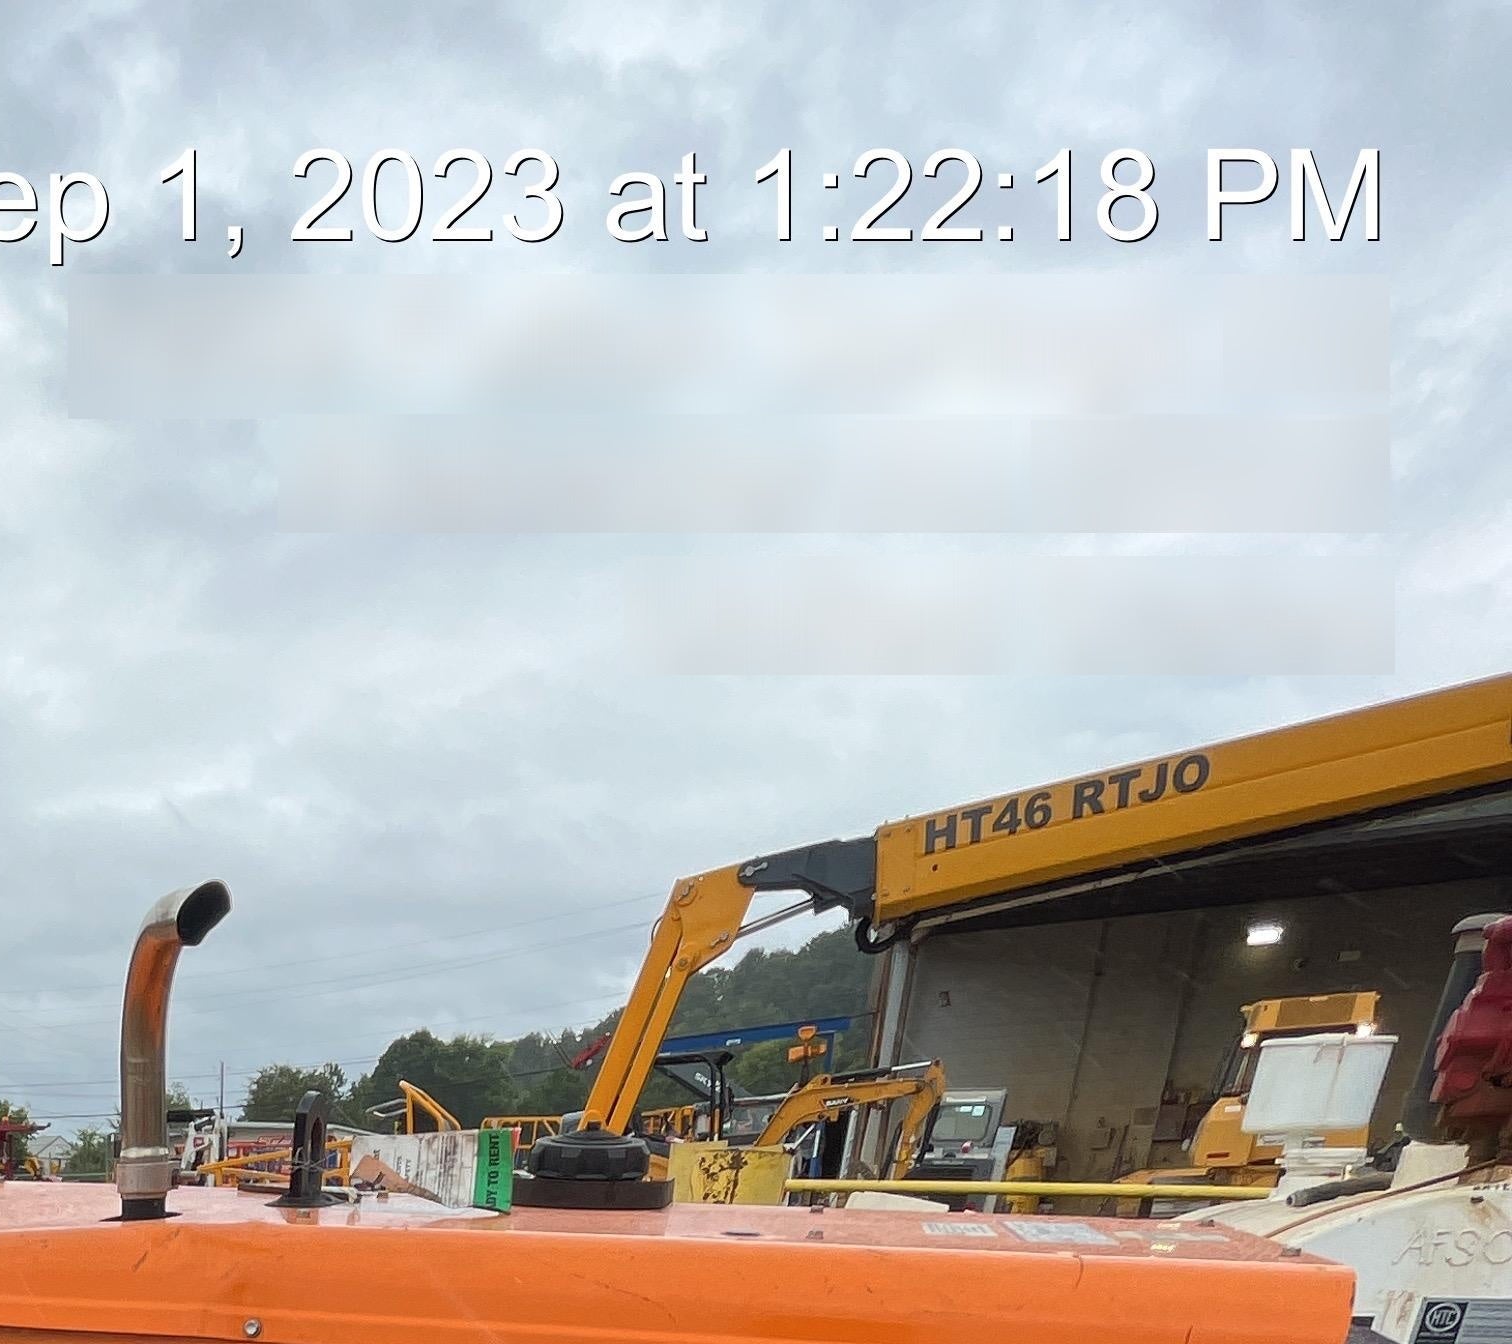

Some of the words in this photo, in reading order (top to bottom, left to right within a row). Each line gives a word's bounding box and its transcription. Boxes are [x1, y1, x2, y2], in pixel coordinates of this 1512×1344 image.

[925, 791, 1054, 856] HT46
[1072, 754, 1211, 821] RTJO
[489, 1133, 499, 1167] RENT
[488, 1170, 499, 1187] TO
